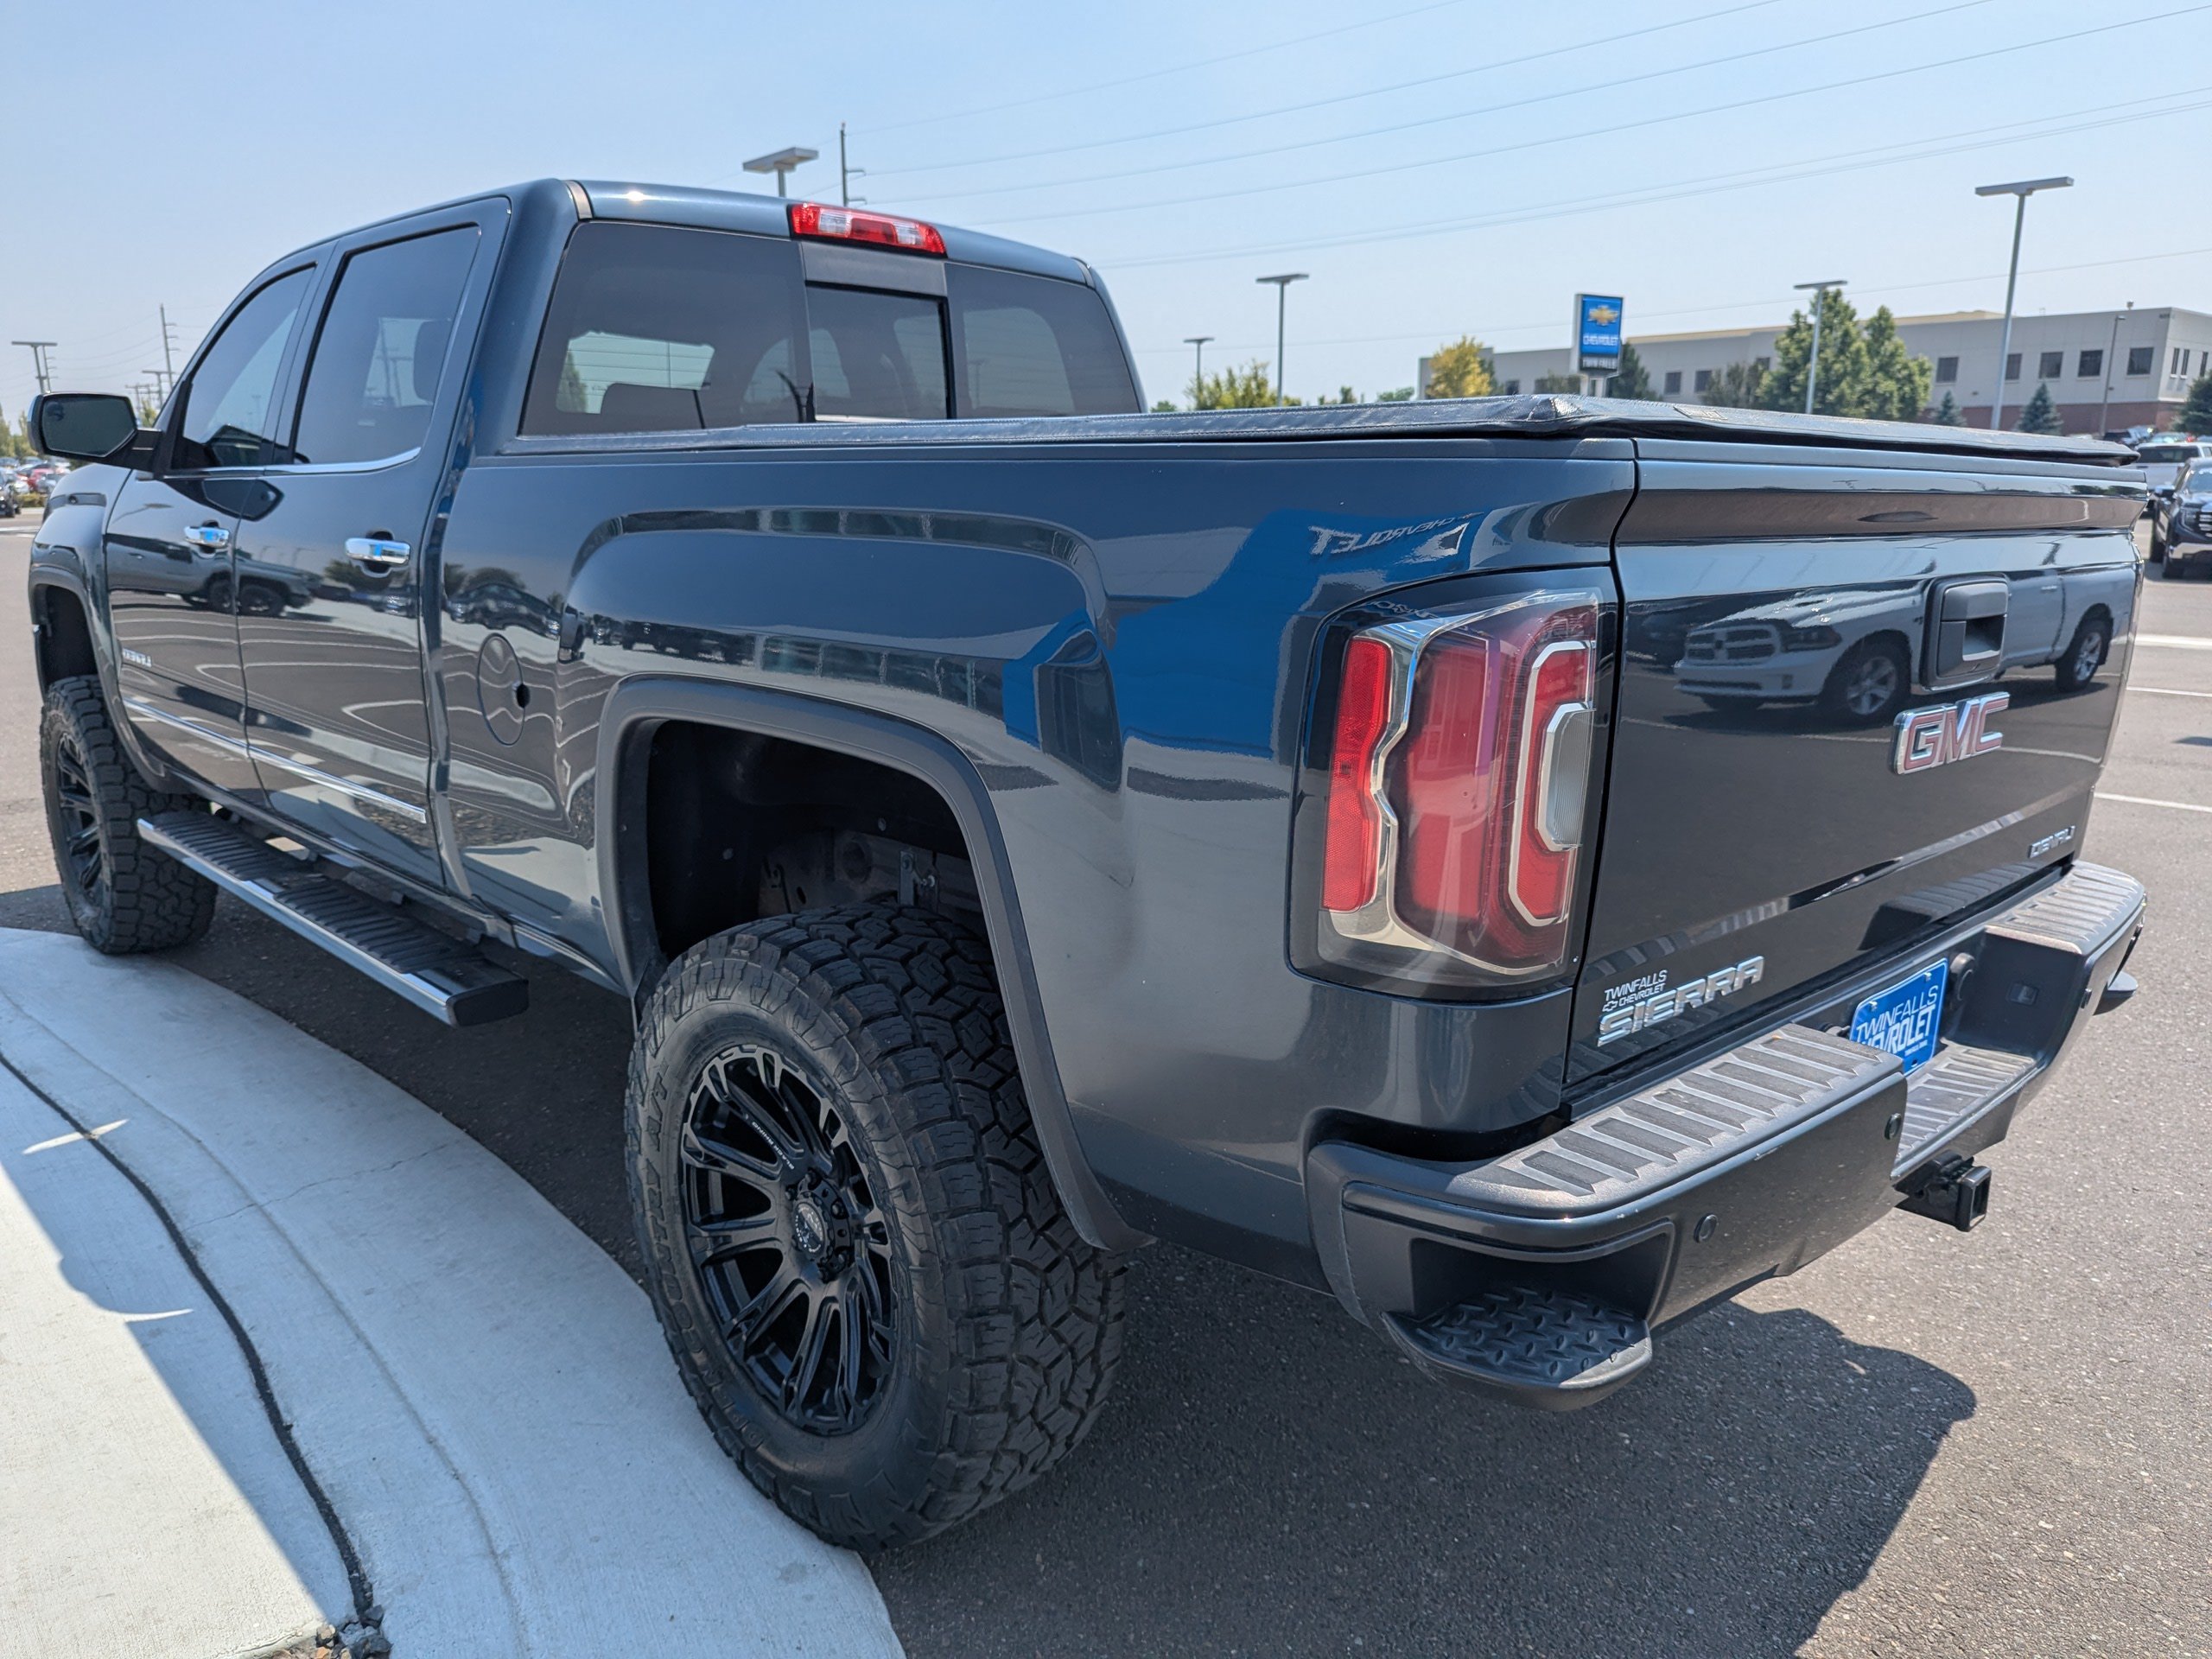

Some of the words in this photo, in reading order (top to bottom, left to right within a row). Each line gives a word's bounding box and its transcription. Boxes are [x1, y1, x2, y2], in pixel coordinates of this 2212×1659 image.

[1583, 334, 1618, 346] CHEVROLET
[1891, 691, 2011, 775] GMC
[1598, 956, 1764, 1047] SIERRA
[1619, 982, 1666, 1007] CHEVROLET
